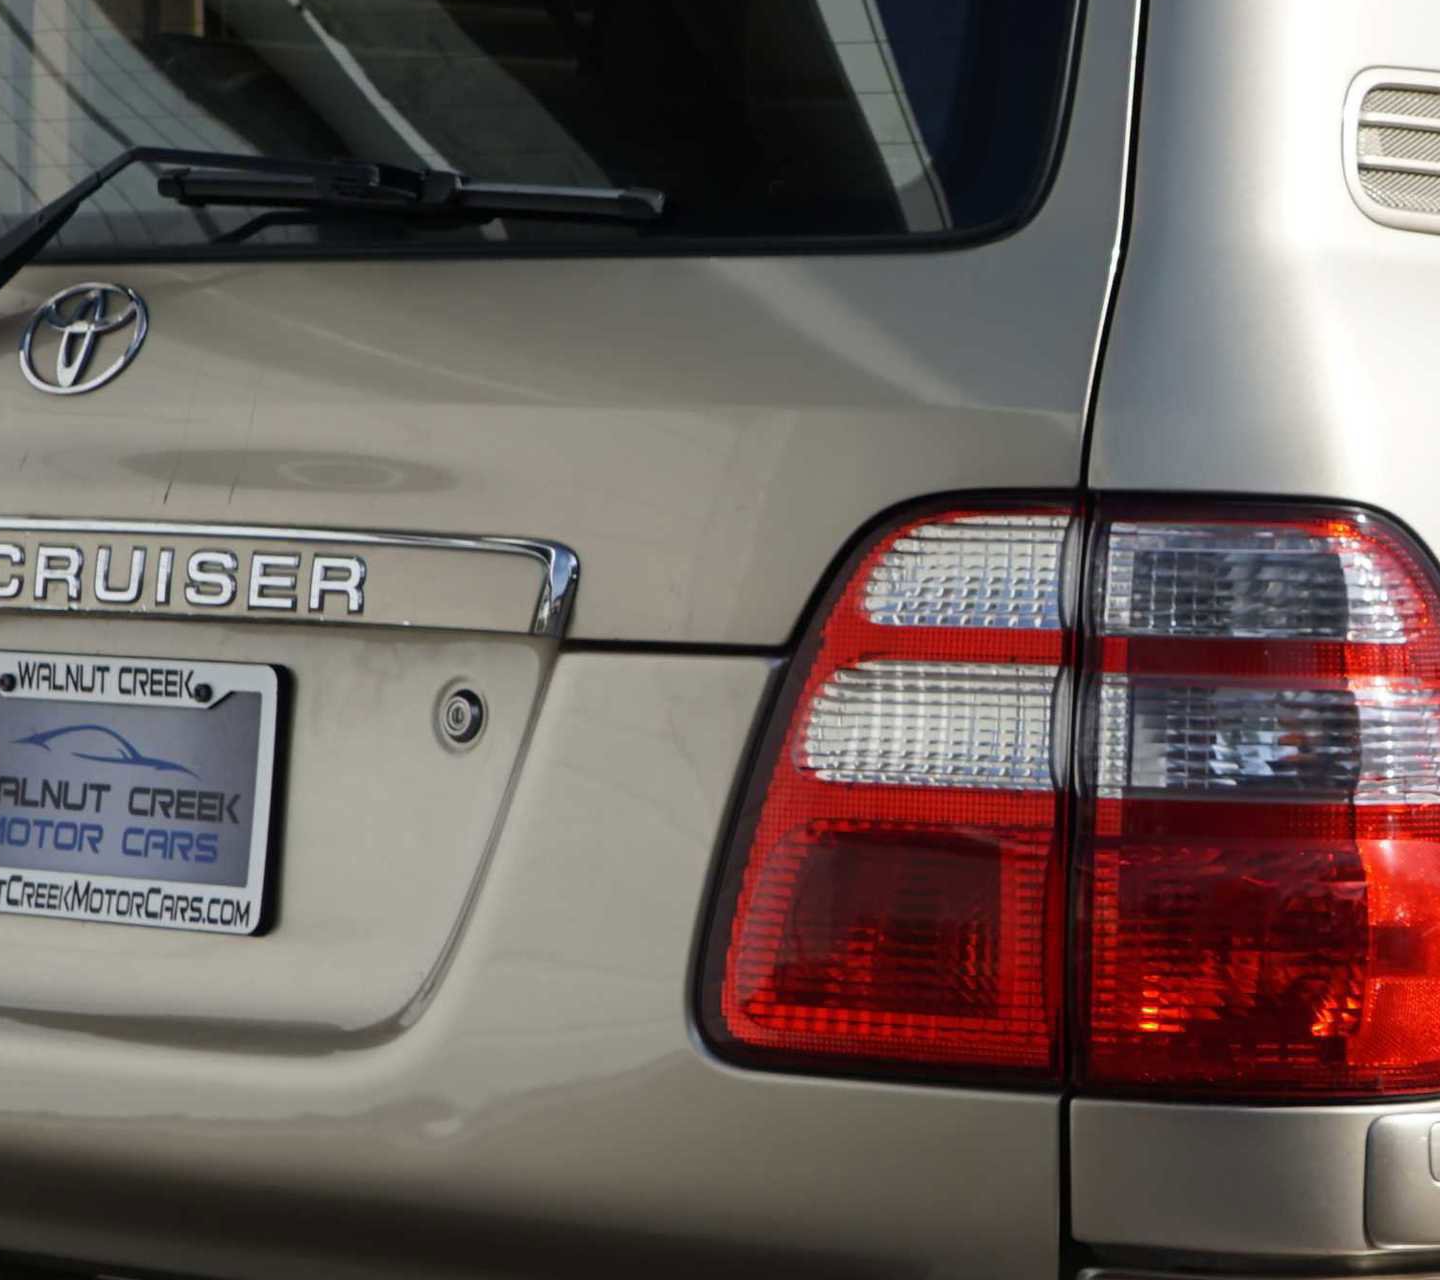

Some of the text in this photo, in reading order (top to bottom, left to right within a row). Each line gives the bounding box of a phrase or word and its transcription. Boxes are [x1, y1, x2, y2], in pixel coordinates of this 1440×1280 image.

[17, 660, 196, 699] WALNUT CREEK
[127, 785, 241, 824] CREEK
[120, 826, 220, 864] CARS
